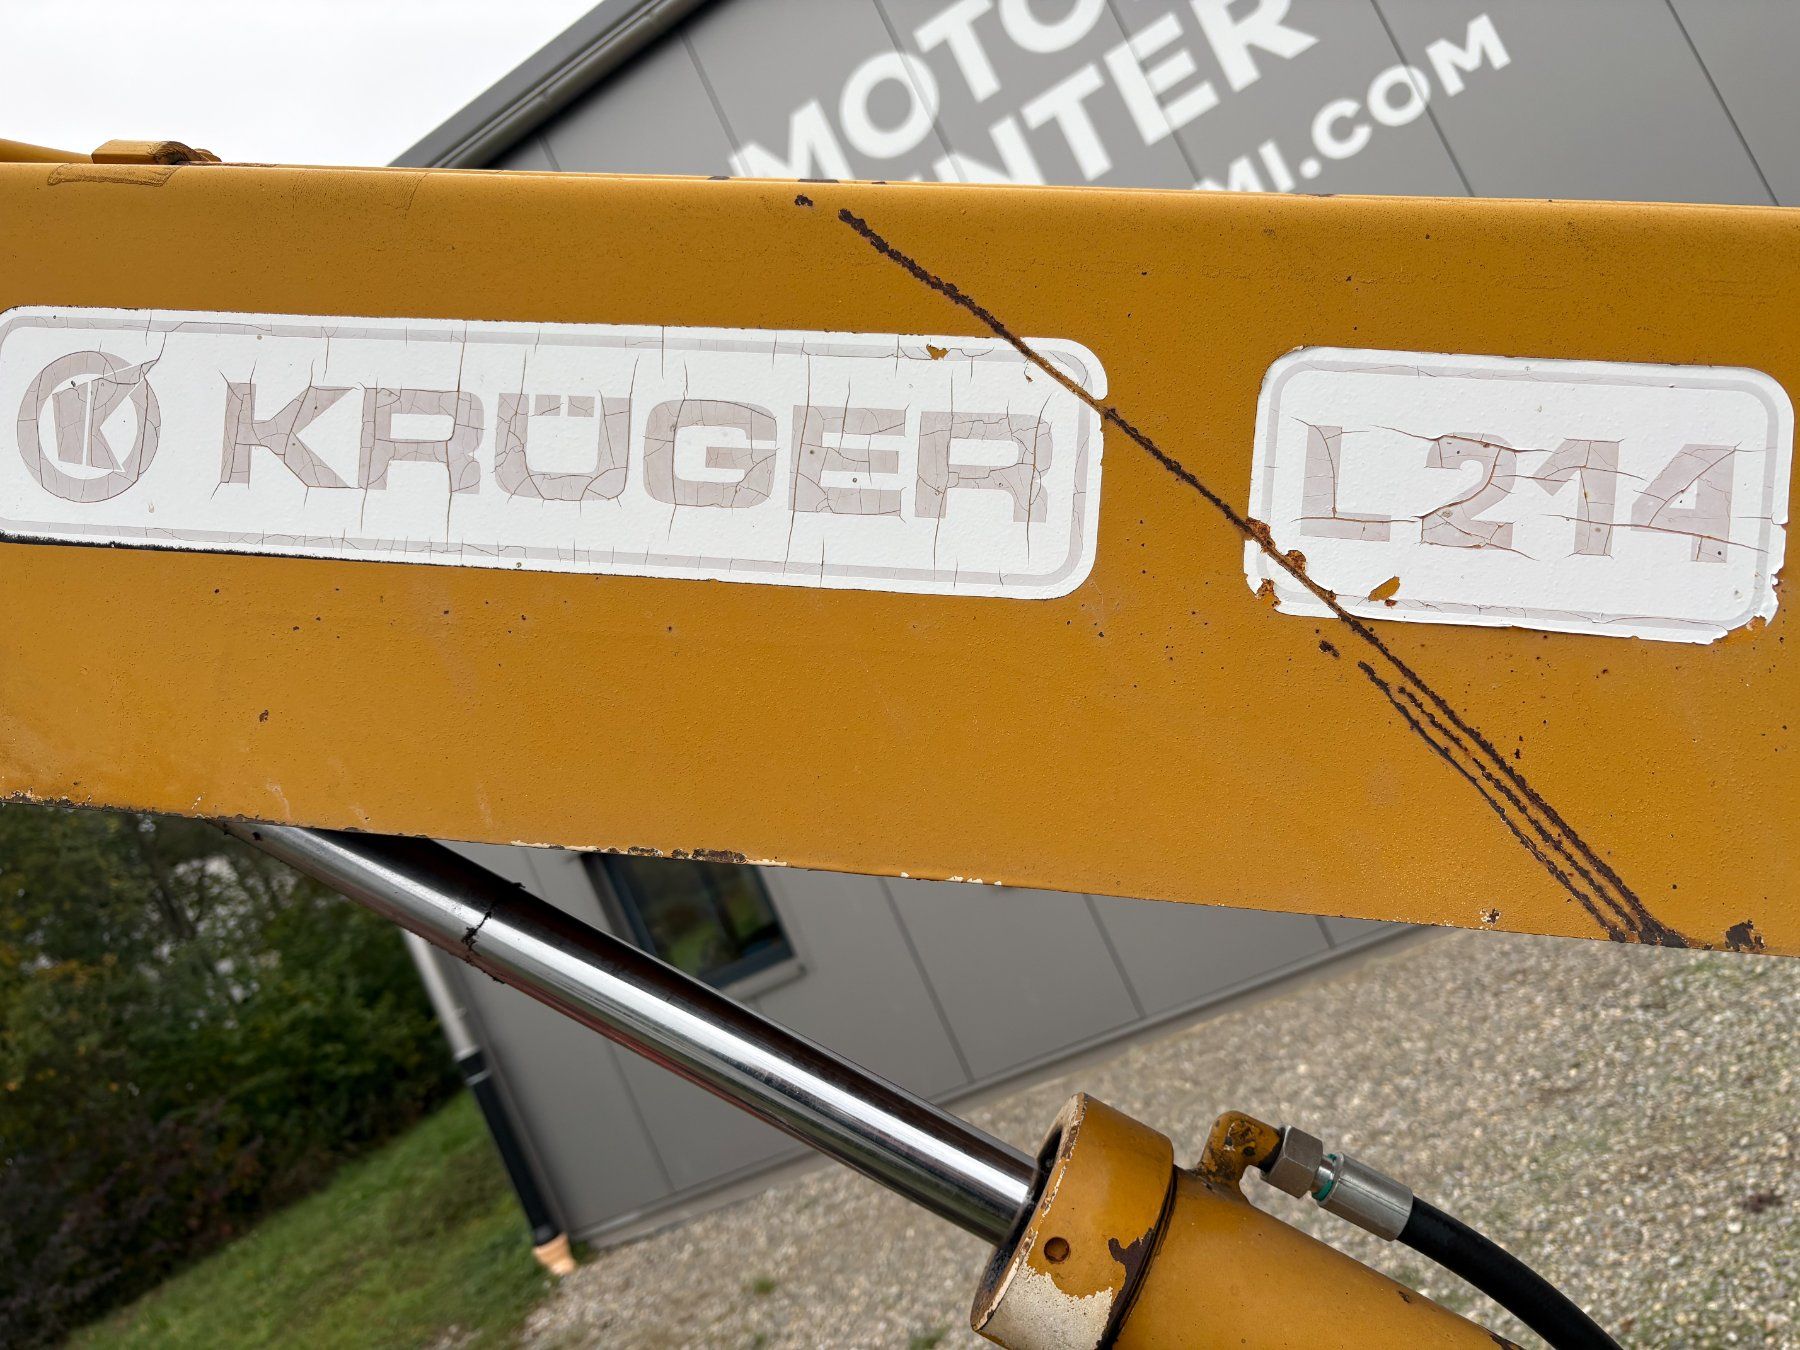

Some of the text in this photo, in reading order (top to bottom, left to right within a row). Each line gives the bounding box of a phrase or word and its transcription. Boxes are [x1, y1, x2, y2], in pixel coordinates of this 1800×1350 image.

[728, 0, 1138, 181] MOTO
[911, 0, 1319, 185] NTER
[223, 382, 1053, 523] KRÜGER
